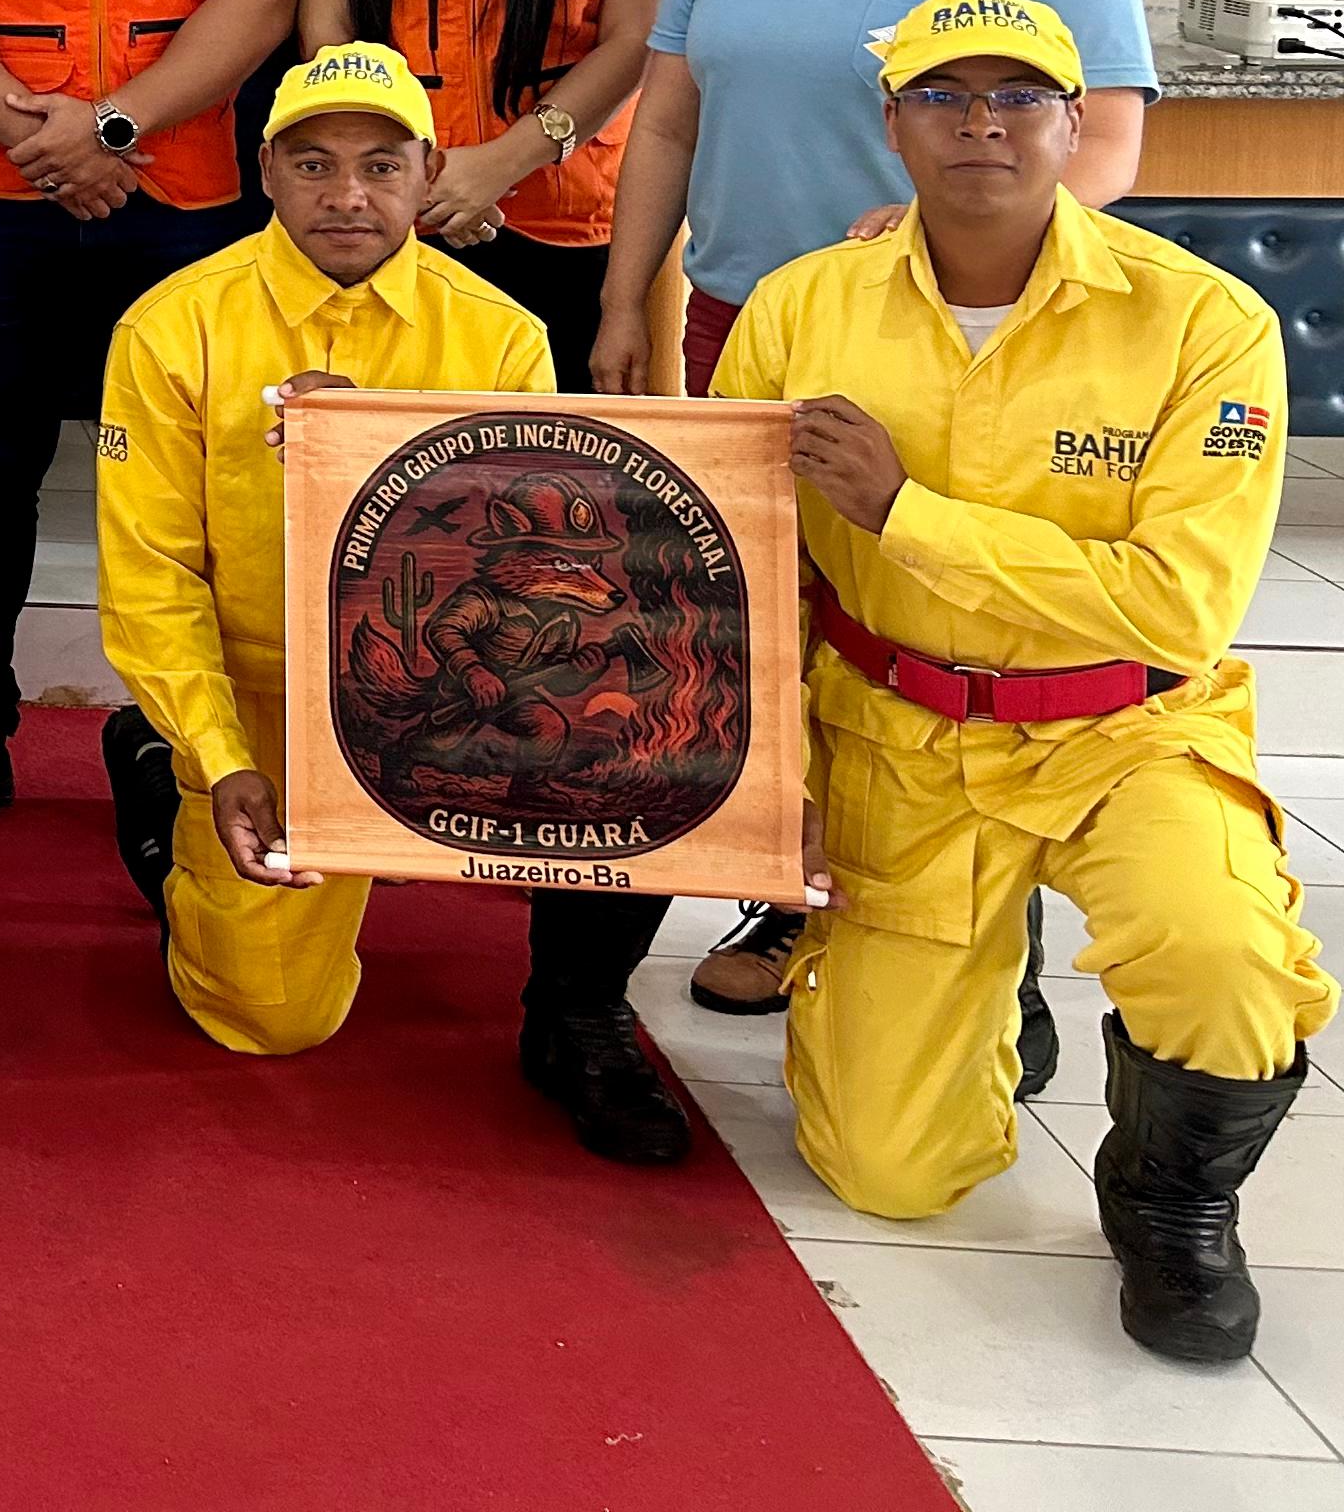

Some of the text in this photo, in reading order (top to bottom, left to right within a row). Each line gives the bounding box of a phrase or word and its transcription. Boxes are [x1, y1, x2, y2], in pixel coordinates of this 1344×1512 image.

[933, 0, 1037, 25] BAHIA
[930, 16, 1039, 37] SEM FOGO
[303, 70, 393, 89] SEM FOGO
[97, 426, 128, 451] HIA
[1204, 437, 1263, 454] DO ESTA
[98, 443, 128, 463] OGO
[1049, 455, 1094, 477] SEM
[342, 421, 734, 582] PRIMEIRO GRUPO DE INCÊNDIO FLORESTAAL
[428, 808, 524, 846] GCIF-1
[460, 856, 632, 889] Juazeiro-Ba
